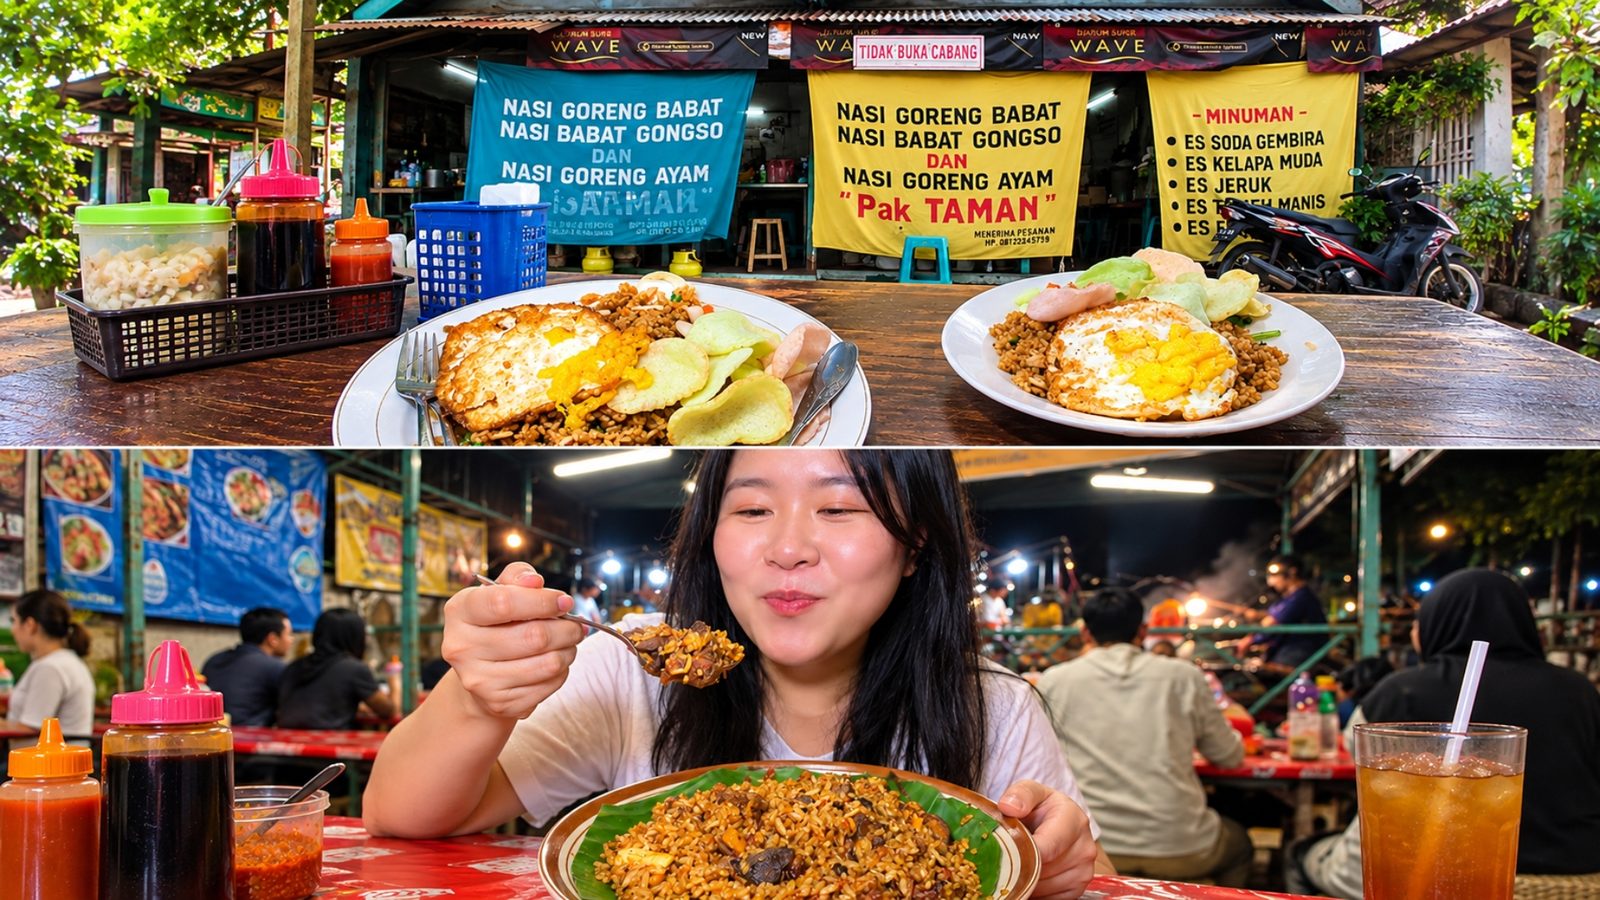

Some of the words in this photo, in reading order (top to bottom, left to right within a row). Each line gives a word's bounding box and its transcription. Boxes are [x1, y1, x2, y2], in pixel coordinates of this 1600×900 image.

[741, 32, 765, 40] NEW
[1274, 33, 1300, 41] NEW
[552, 40, 619, 52] WAVE
[859, 44, 893, 60] TIDAK
[897, 44, 929, 60] BUKA
[930, 44, 978, 60] CABANG
[1071, 40, 1144, 52] WAVE
[504, 99, 551, 118] NASI
[562, 103, 646, 120] GORENG
[657, 99, 722, 118] BABAT
[837, 102, 885, 123] NASI
[896, 107, 981, 125] GORENG
[993, 102, 1061, 124] BABAT
[1207, 107, 1293, 124] MINUMAN
[501, 120, 548, 140] NASI
[558, 125, 626, 143] BABAT
[637, 122, 723, 142] GONGSO
[838, 126, 884, 147] NASI
[895, 131, 962, 149] BABAT
[973, 126, 1061, 148] GONGSO
[1185, 135, 1205, 150] ES
[1211, 135, 1252, 150] SODA
[1257, 131, 1324, 149] GEMBIRA
[592, 149, 631, 163] DAN
[928, 154, 966, 168] DAN
[1186, 156, 1207, 172] ES
[1213, 156, 1273, 172] KELAPA
[1280, 152, 1322, 170] MUDA
[502, 161, 551, 183] NASI
[561, 167, 645, 185] GORENG
[655, 165, 708, 184] AYAM
[844, 167, 891, 188] NASI
[903, 172, 988, 190] GORENG
[998, 169, 1052, 190] AYAM
[1187, 177, 1208, 193] ES
[1214, 175, 1272, 193] JERUK
[1187, 199, 1207, 214] ES
[1279, 194, 1325, 210] MANIS
[1188, 220, 1210, 235] ES
